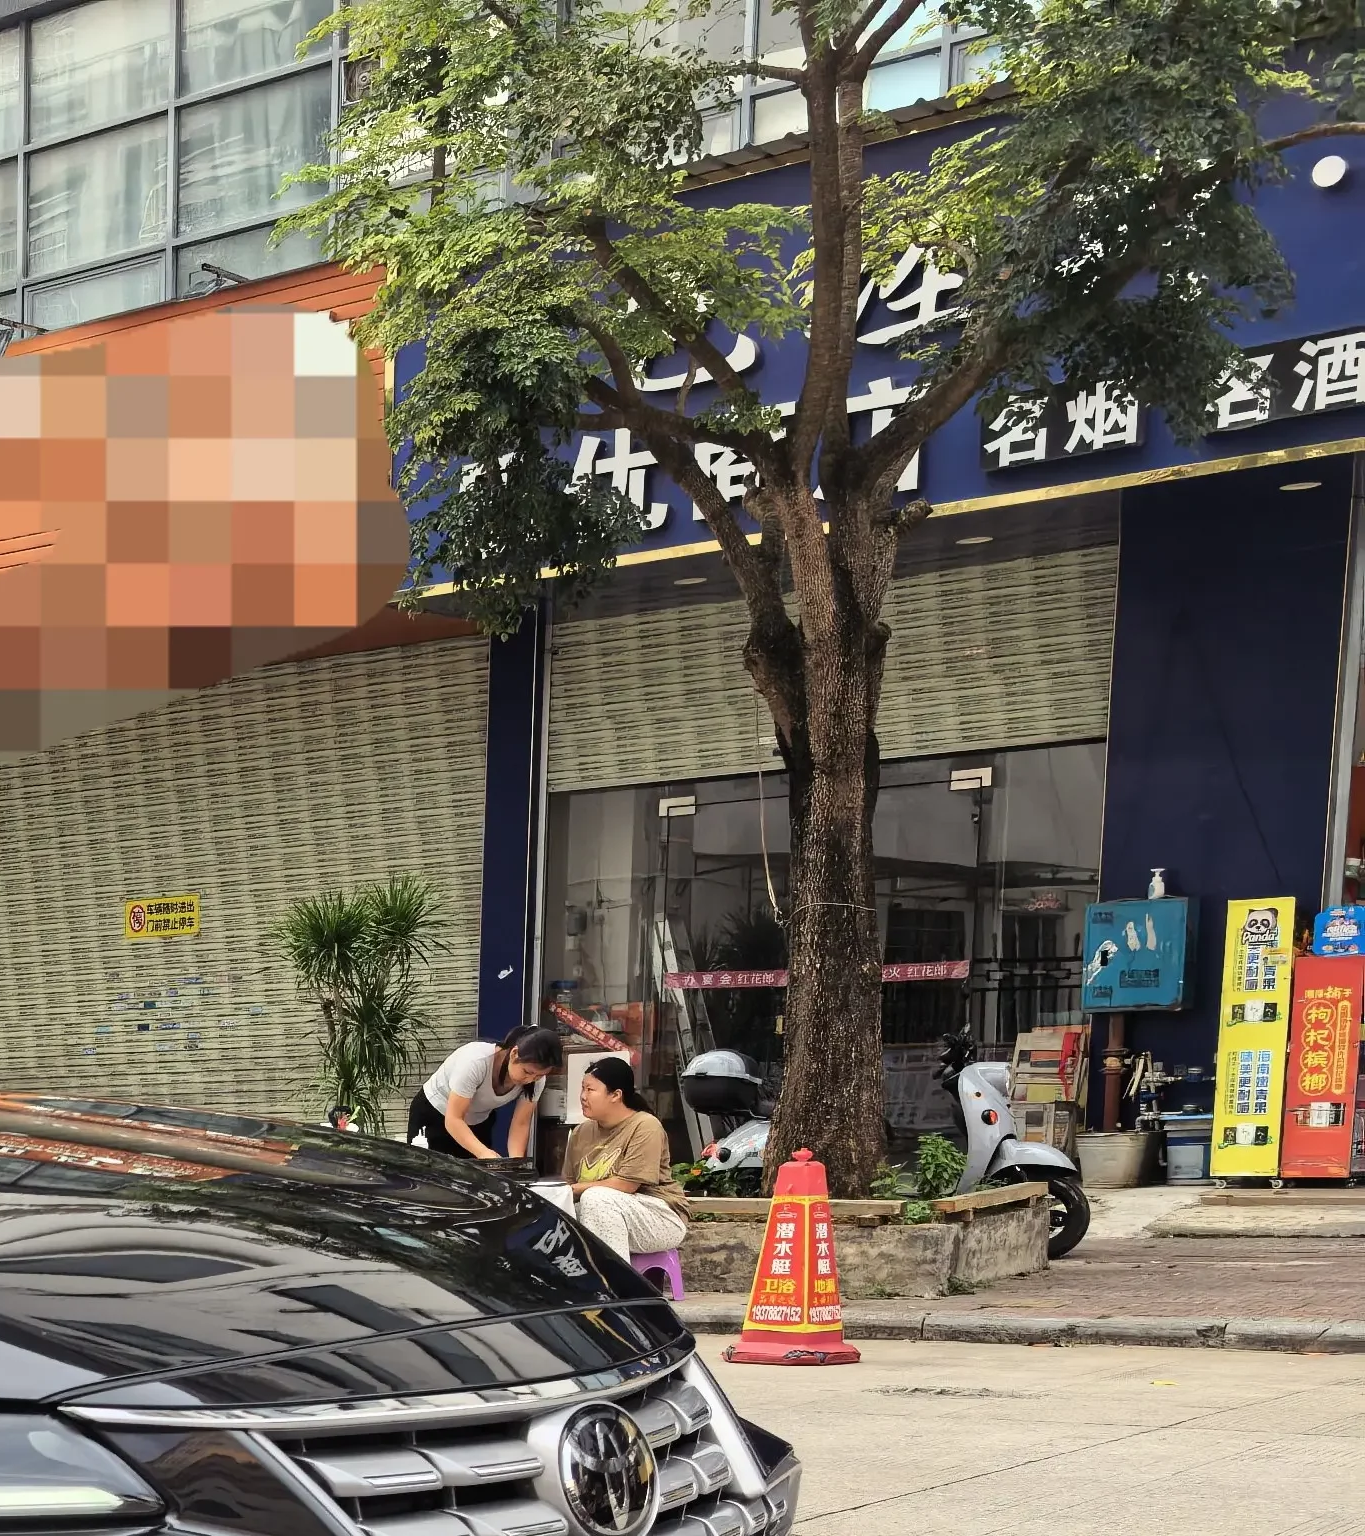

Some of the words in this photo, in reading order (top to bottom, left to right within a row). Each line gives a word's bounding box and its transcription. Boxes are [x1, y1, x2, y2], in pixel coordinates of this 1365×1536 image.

[1302, 1006, 1332, 1091] 枸杞槟榔
[770, 1222, 796, 1275] 潜水艇
[760, 1278, 797, 1294] 卫浴
